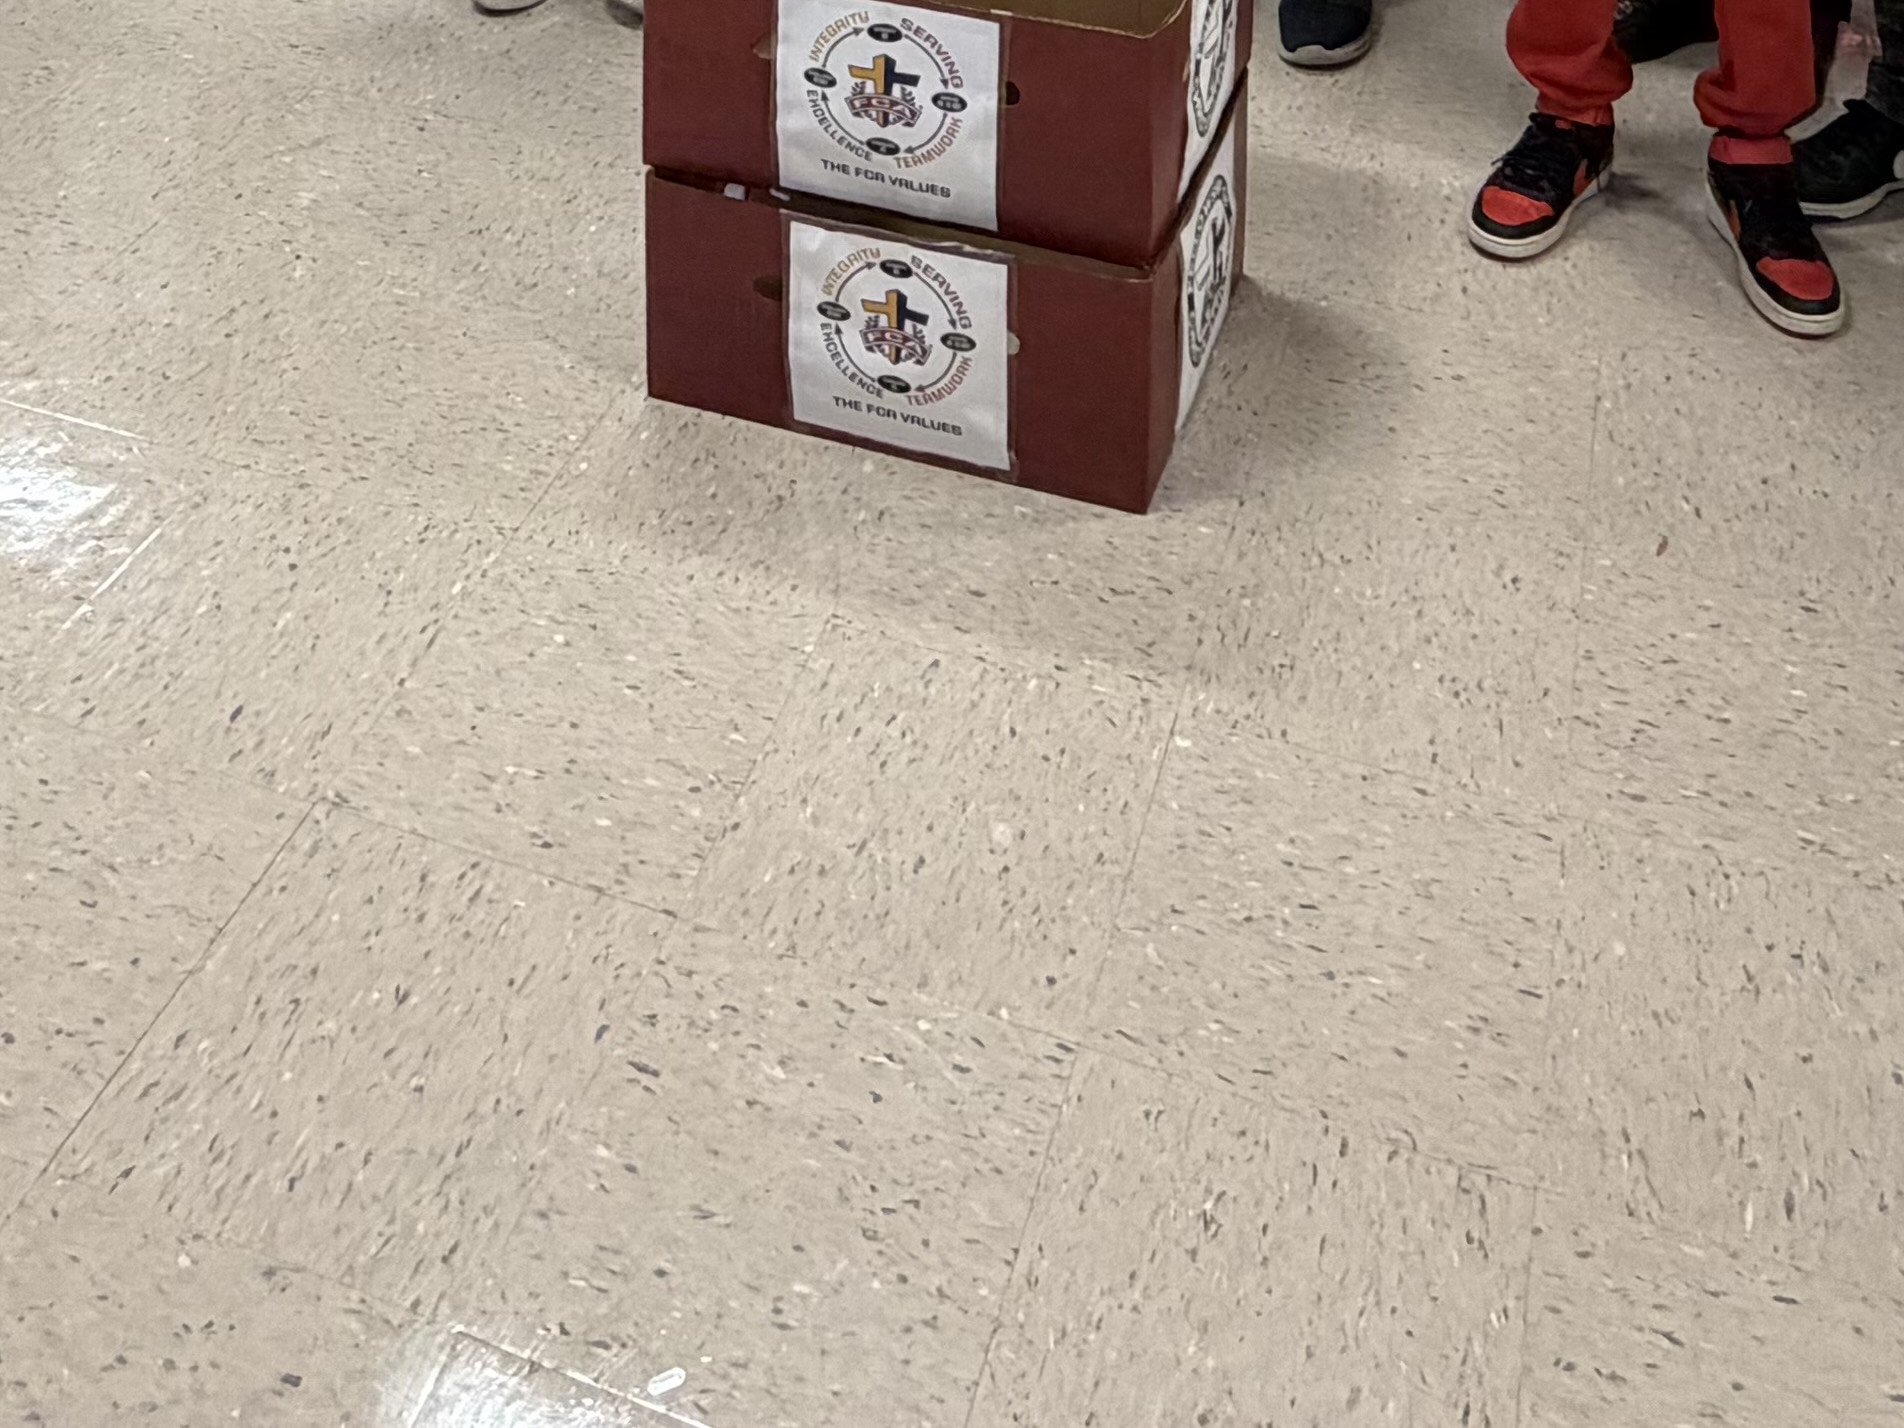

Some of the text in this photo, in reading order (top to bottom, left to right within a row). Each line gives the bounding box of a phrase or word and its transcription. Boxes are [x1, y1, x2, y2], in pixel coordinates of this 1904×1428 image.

[807, 10, 870, 63] INTEGRITY
[899, 17, 964, 90] SERVING
[806, 89, 874, 162] EXCELLENCE
[851, 96, 914, 120] FCA
[893, 116, 964, 170] TEAMWORK
[820, 158, 952, 199] THE FCA VALUES
[820, 246, 882, 297] INTEGRITY
[909, 254, 973, 330] SERVING
[819, 321, 885, 400] EXCELLENCE
[866, 330, 930, 357] FCA
[904, 355, 974, 407] TEAMWORK
[832, 395, 963, 437] THE FCA VALUES
